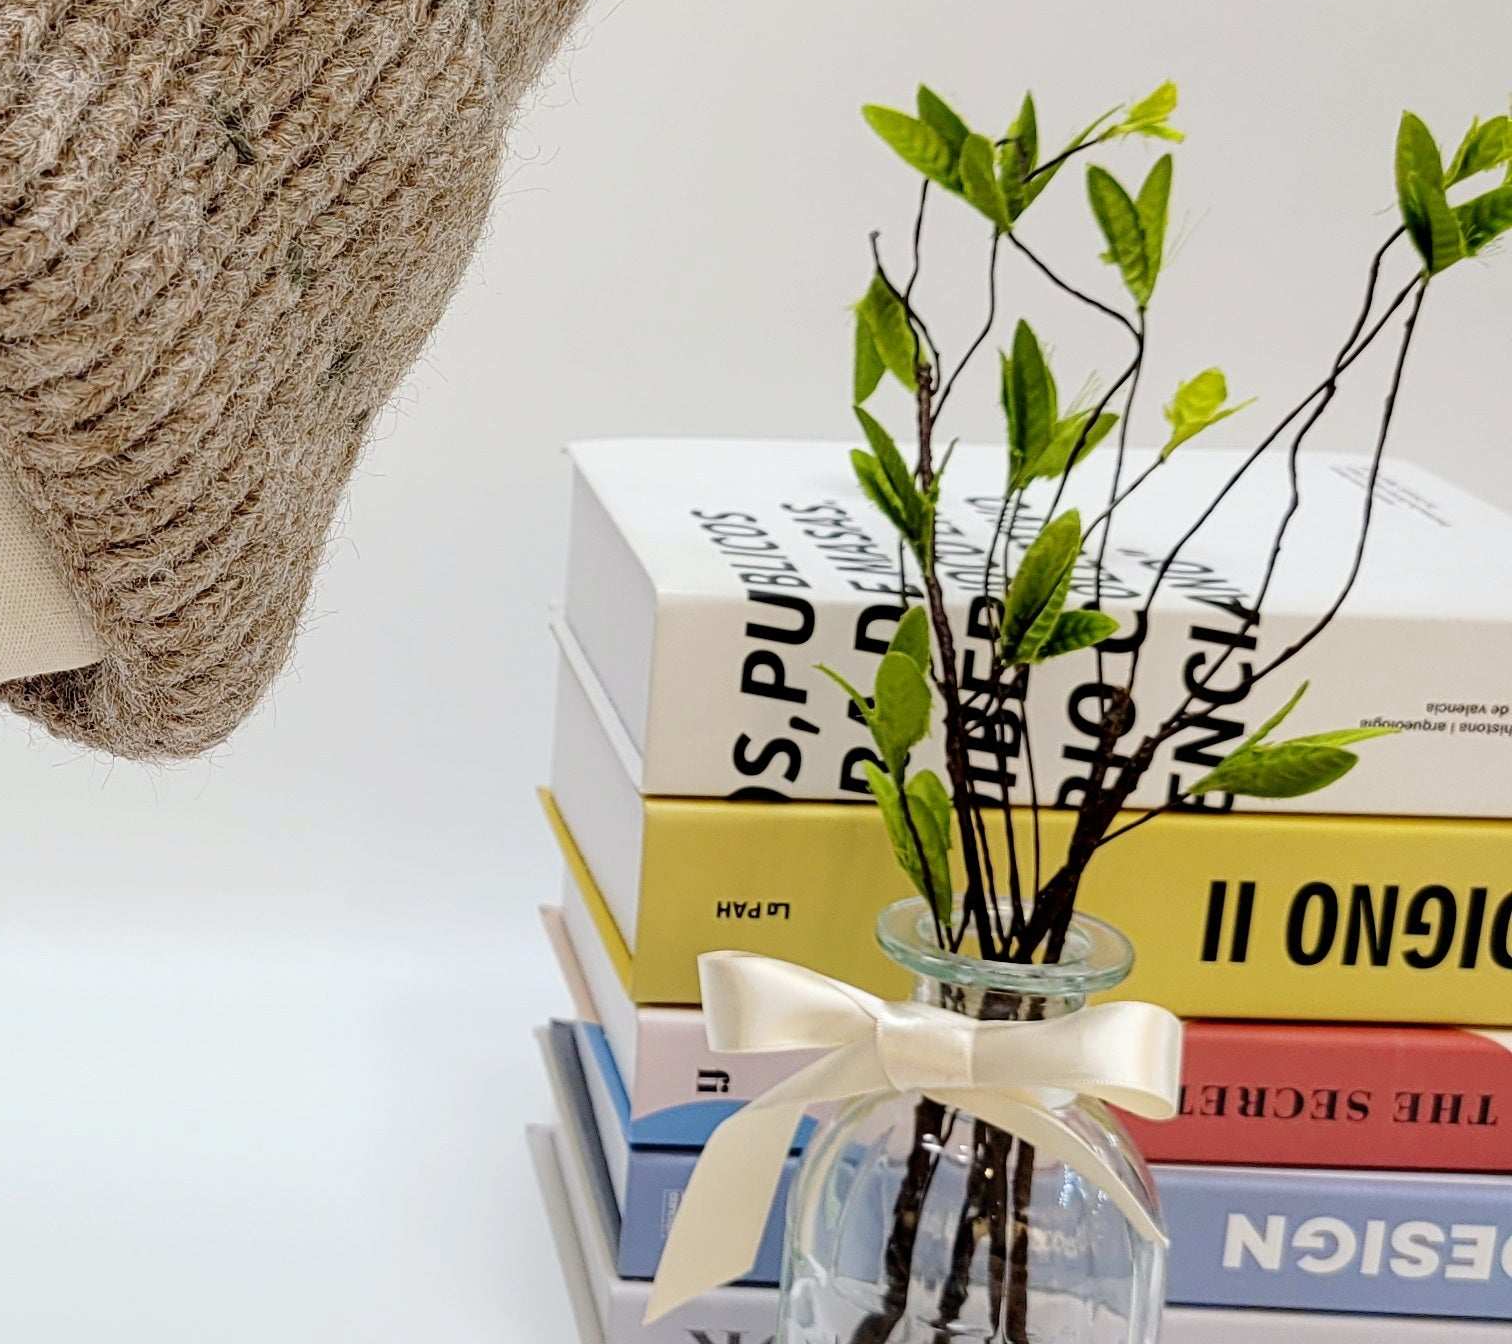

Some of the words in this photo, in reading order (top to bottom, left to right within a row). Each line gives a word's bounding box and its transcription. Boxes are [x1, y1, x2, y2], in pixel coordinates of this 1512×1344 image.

[1426, 703, 1488, 716] valencia
[1491, 705, 1509, 717] de
[716, 901, 761, 919] PAH
[767, 902, 791, 919] La
[1393, 1091, 1498, 1127] THE
[1223, 1213, 1512, 1281] ESIGN
